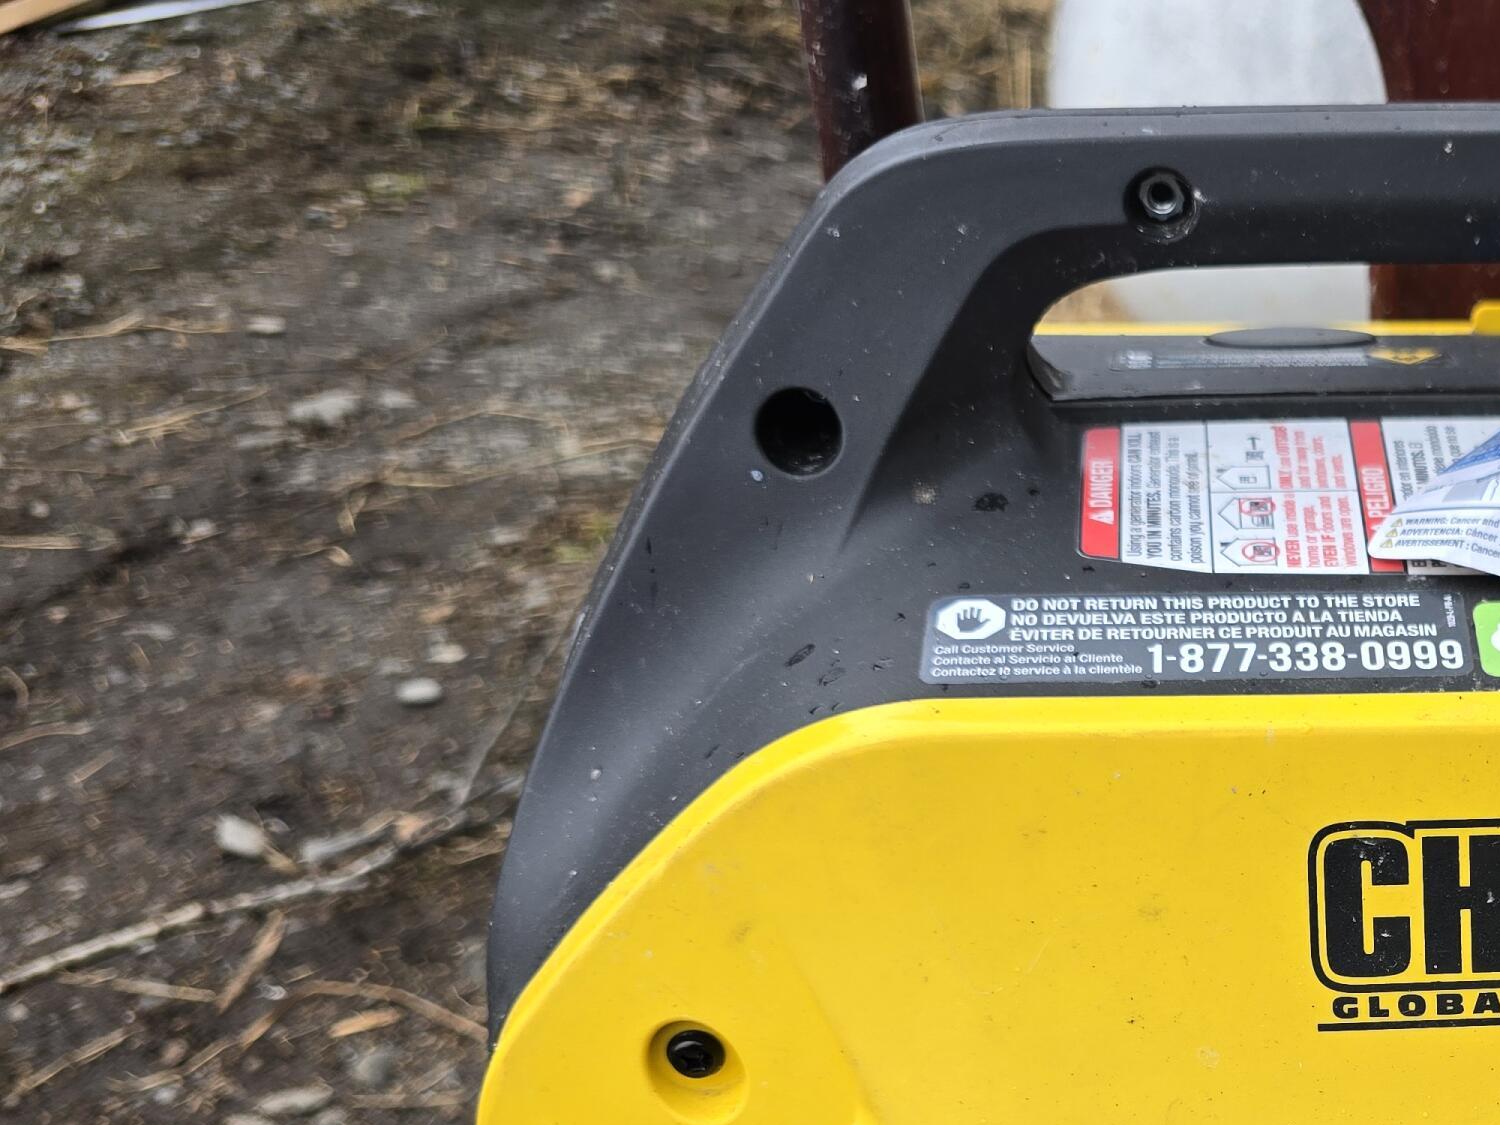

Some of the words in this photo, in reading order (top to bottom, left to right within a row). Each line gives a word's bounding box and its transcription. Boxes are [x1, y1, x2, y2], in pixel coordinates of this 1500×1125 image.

[1088, 459, 1114, 508] DANGER
[1360, 467, 1390, 518] PELIGRO
[1128, 491, 1146, 526] generator
[1146, 490, 1162, 528] MINUTES.
[1166, 500, 1181, 527] carbon
[1187, 494, 1201, 520] cannot
[1188, 521, 1206, 536] you
[1400, 528, 1463, 536] ADVERTENCIA:
[1481, 518, 1499, 529] and
[1146, 530, 1162, 540] IN
[1166, 528, 1182, 562] contains
[1321, 534, 1336, 543] IF
[1395, 539, 1464, 549] AVERTISSEMENT
[1126, 535, 1145, 557] Using
[1146, 542, 1162, 559] YOU
[1186, 537, 1206, 564] poison
[1285, 539, 1302, 568] NEVER
[1322, 545, 1338, 567] EVEN
[1305, 545, 1320, 568] home
[1011, 598, 1039, 612] DO
[1043, 598, 1081, 611] NOT
[1084, 597, 1158, 611] RETURN
[1163, 597, 1203, 610] THIS
[1208, 596, 1291, 609] PRODUCT
[1296, 595, 1320, 608] TO
[1324, 595, 1360, 608] THE
[1363, 594, 1421, 607] STORE
[1010, 613, 1039, 627] NO
[1042, 613, 1137, 626] DEVUELVA
[1140, 612, 1186, 625] ESTE
[1191, 610, 1288, 624] PRODUCTO
[1292, 609, 1306, 623] A
[1310, 609, 1334, 622] LA
[1338, 609, 1403, 622] TIENDA
[1009, 626, 1074, 641] ÉVITER
[1078, 628, 1102, 641] DE
[1105, 626, 1215, 641] RETOURNER
[1219, 625, 1243, 639] CE
[1246, 625, 1324, 639] PRODUIT
[1326, 624, 1351, 638] AU
[1354, 624, 1438, 637] MAGASIN
[933, 655, 991, 666] Contacte
[994, 654, 1006, 665] al
[1009, 653, 1061, 664] Servicio
[1064, 654, 1076, 664] al
[1079, 652, 1124, 663] Cliente
[934, 644, 959, 655] Call
[961, 643, 1024, 655] Customer
[1026, 643, 1075, 654] Service
[1147, 639, 1464, 674] 1-877-338-0999
[931, 666, 997, 678] Contactez
[998, 666, 1011, 677] le
[1013, 666, 1061, 676] service
[1062, 664, 1072, 675] à
[1074, 664, 1086, 675] la
[1089, 663, 1143, 675] clientèle
